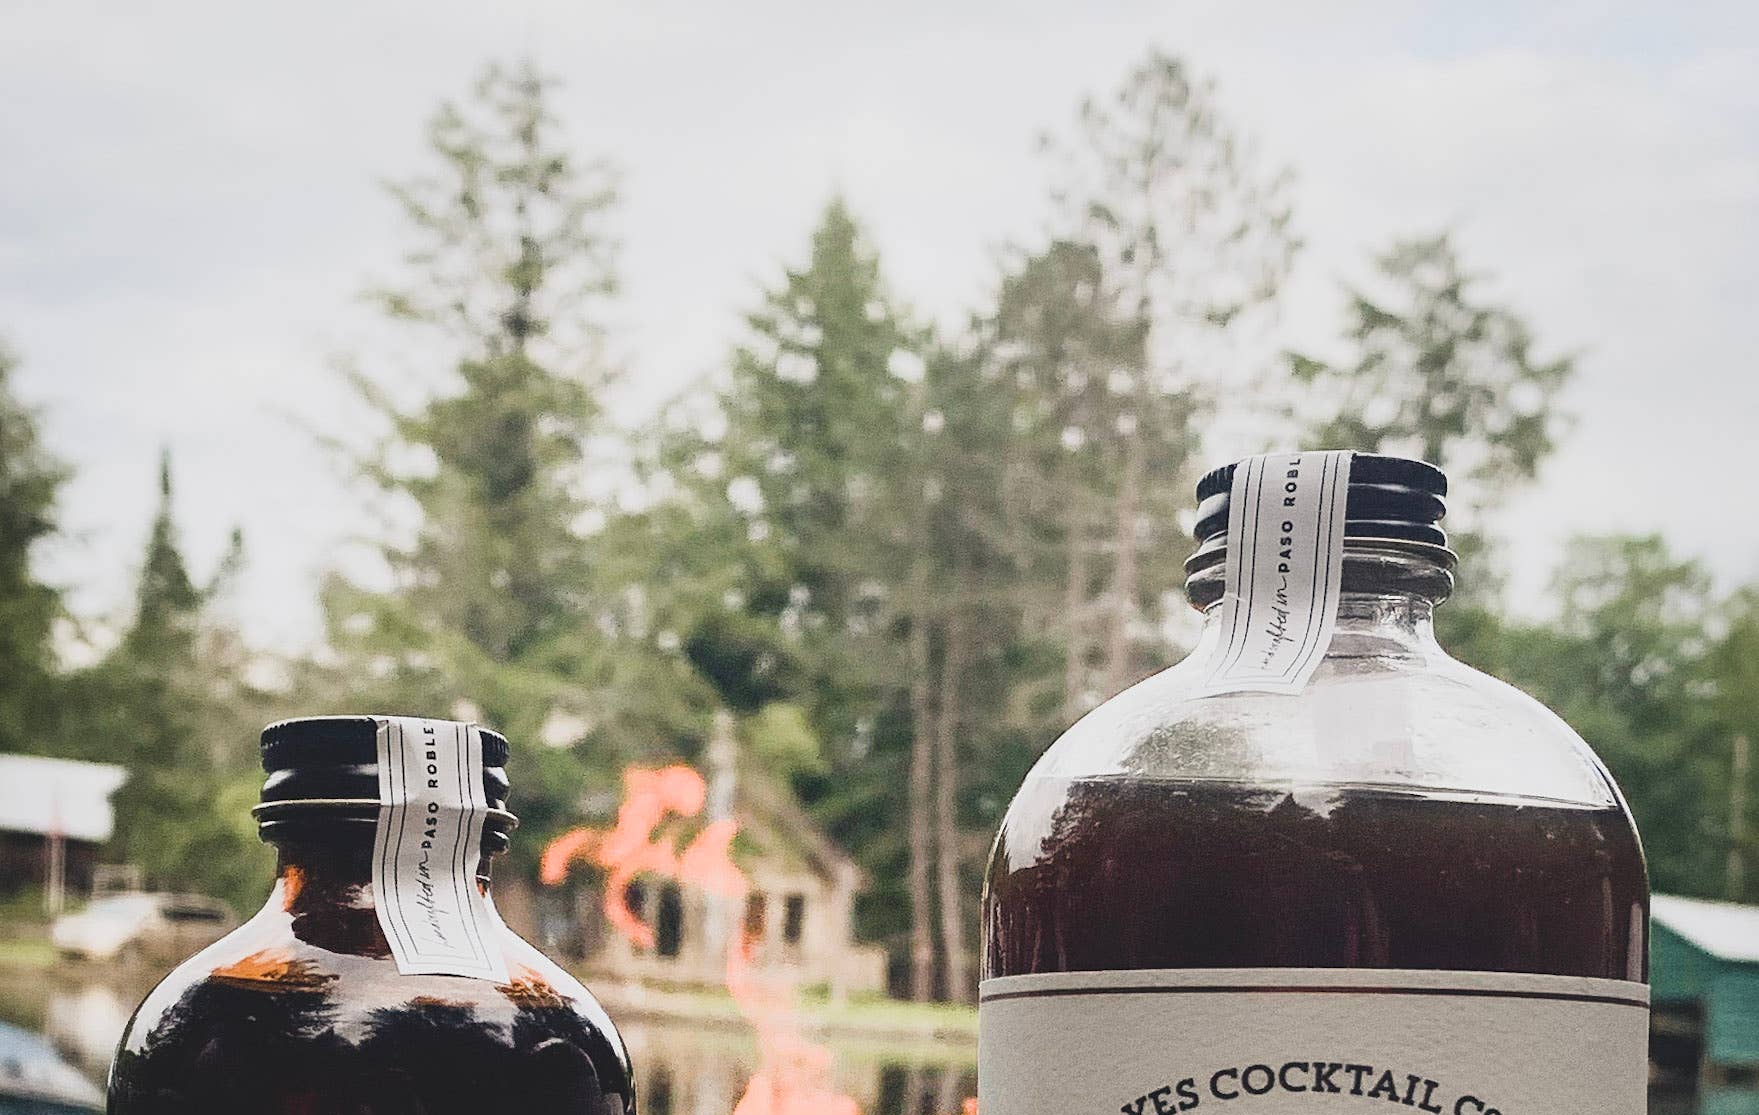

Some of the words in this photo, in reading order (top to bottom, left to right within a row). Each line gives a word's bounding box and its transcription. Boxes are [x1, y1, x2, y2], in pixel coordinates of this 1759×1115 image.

[1278, 520, 1294, 572] PASO
[423, 724, 438, 788] ROBLE
[421, 801, 439, 848] PASO
[1209, 1061, 1443, 1115] COCKTAIL
